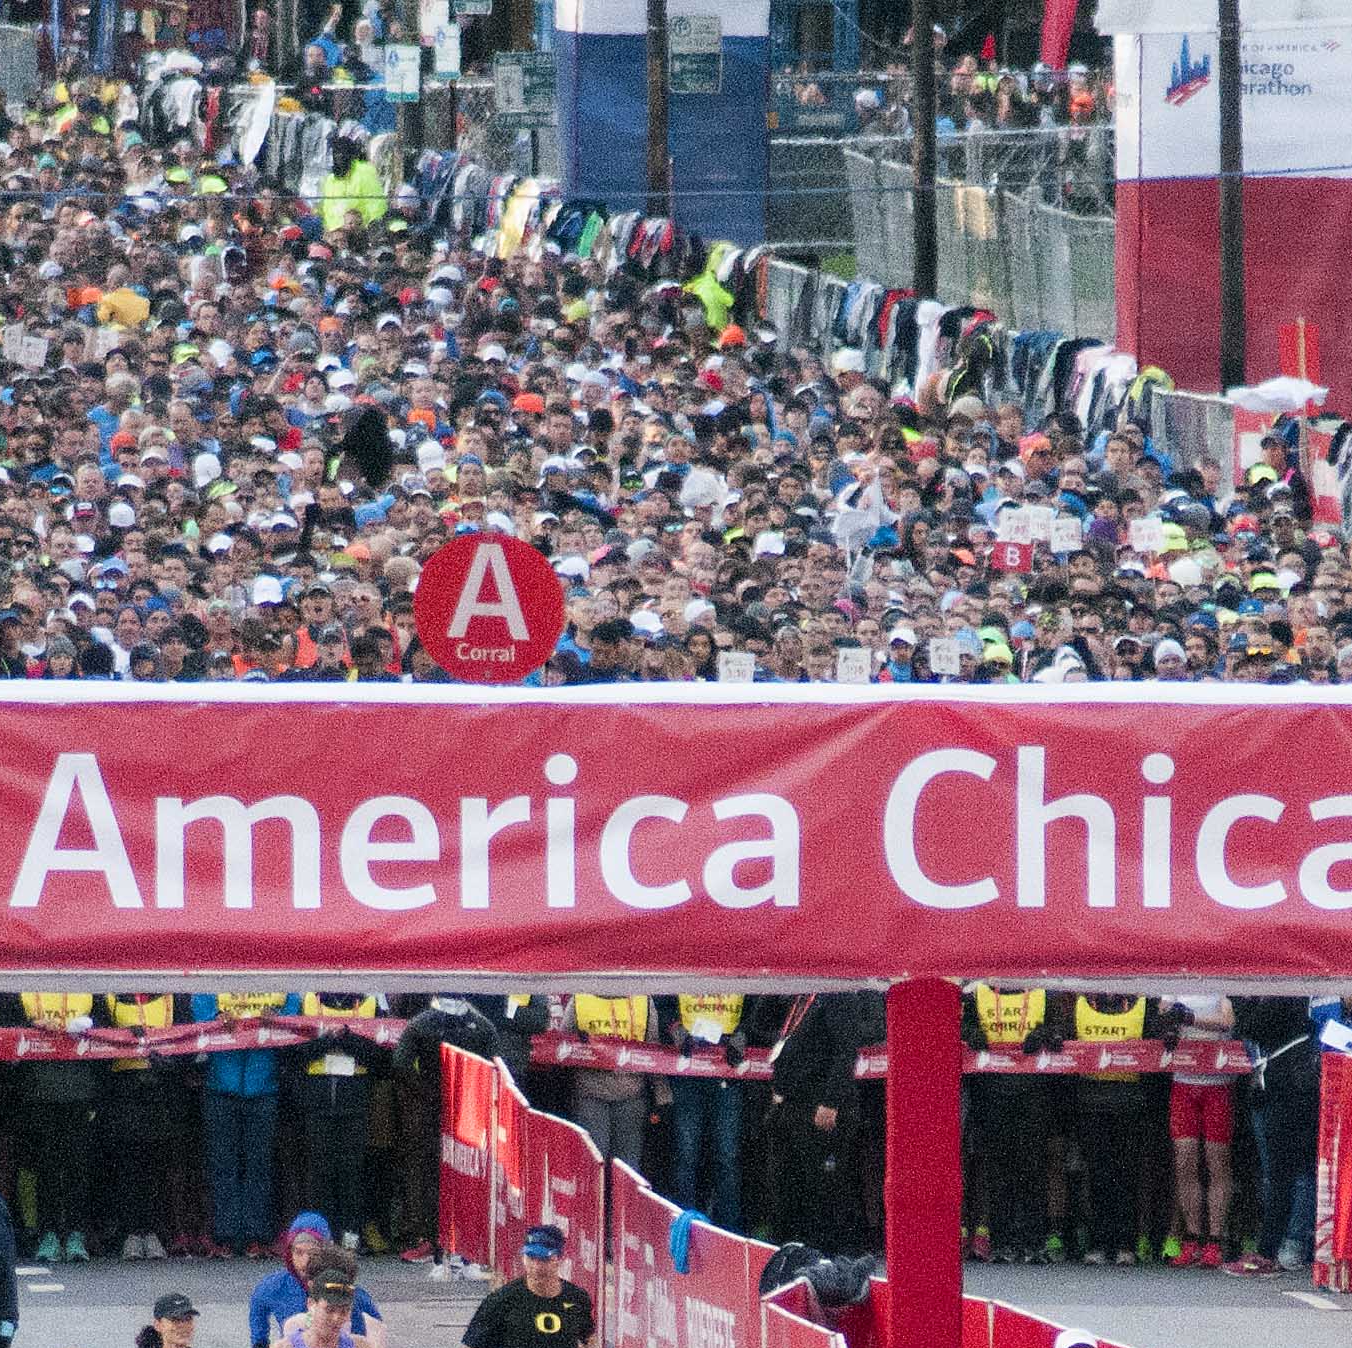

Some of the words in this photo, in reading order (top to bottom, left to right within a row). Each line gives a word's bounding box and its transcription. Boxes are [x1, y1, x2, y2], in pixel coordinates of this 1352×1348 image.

[1241, 59, 1295, 80] icago
[1240, 79, 1313, 97] arathon
[1004, 548, 1022, 568] B
[447, 542, 531, 640] A
[455, 642, 515, 664] Corral
[7, 752, 802, 914] America
[1085, 1024, 1127, 1036] START
[536, 1312, 562, 1334] O
